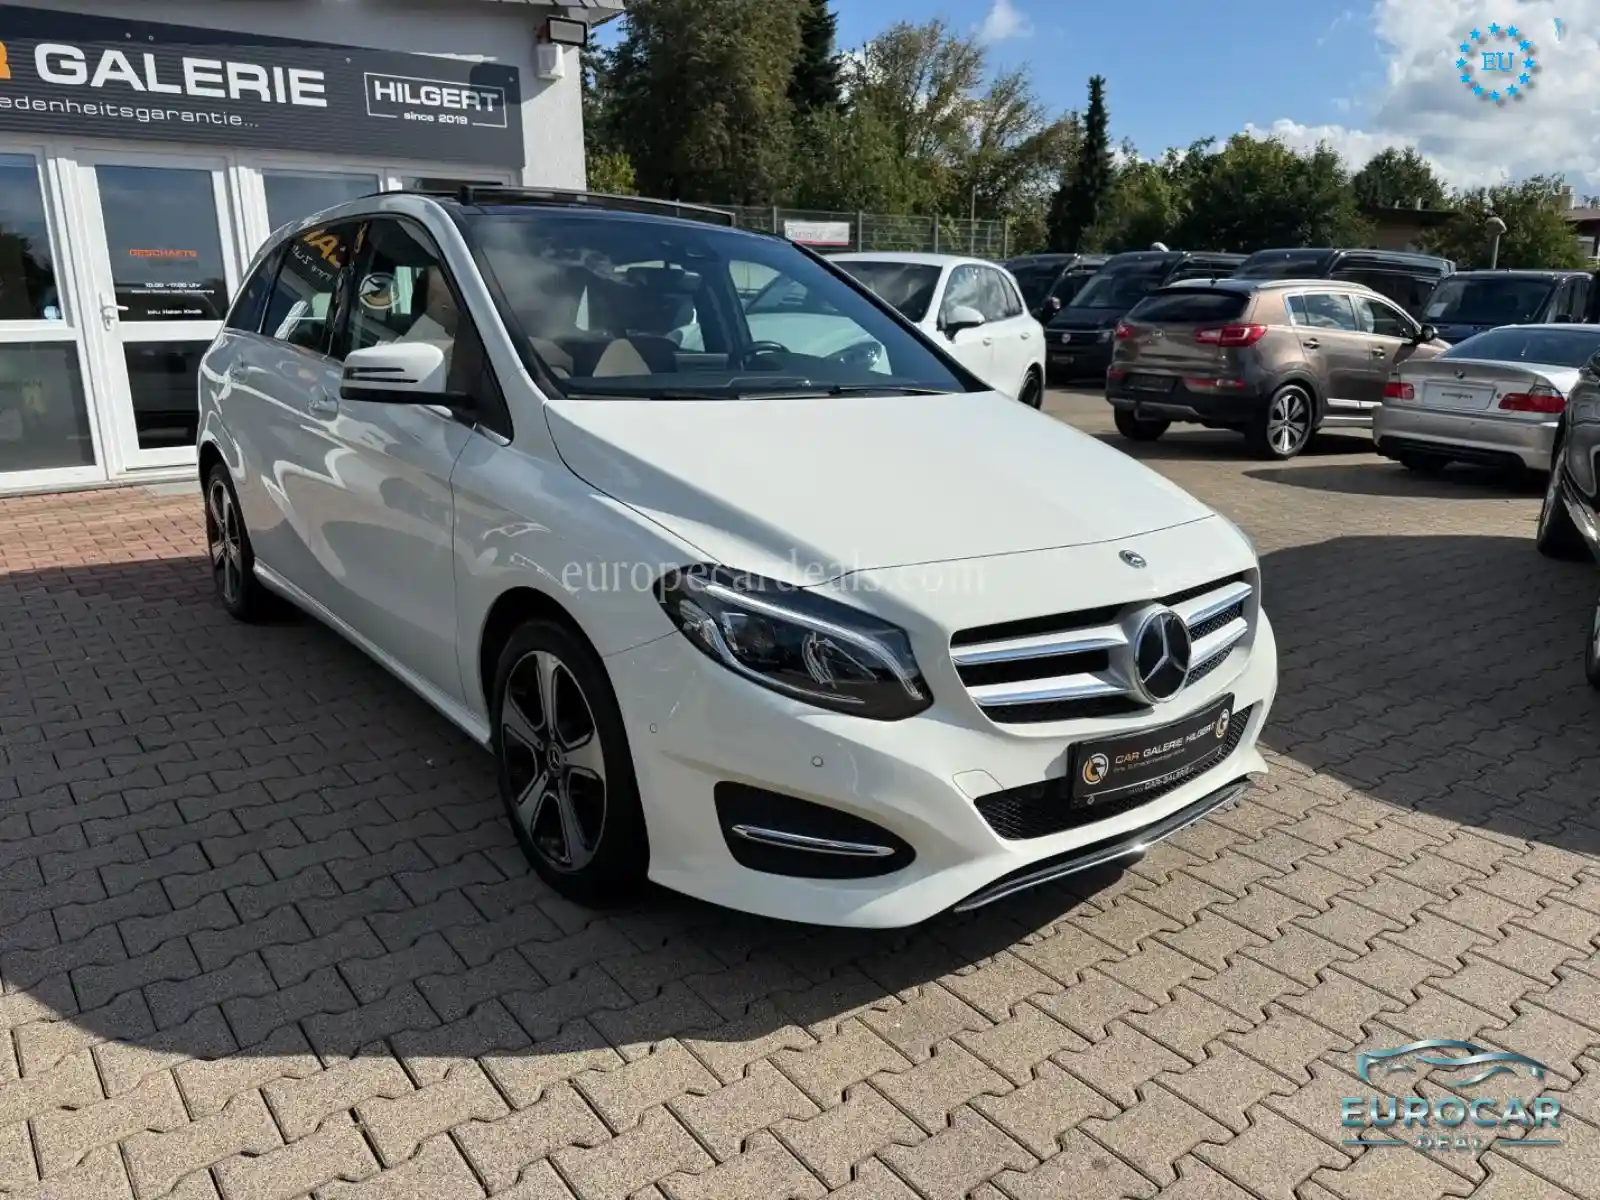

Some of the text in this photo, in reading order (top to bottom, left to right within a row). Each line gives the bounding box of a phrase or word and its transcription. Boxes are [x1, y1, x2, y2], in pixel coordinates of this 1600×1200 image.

[34, 43, 327, 107] GALERIE
[374, 80, 499, 112] HILGERT
[403, 111, 468, 125] since 2019
[1114, 751, 1141, 765] CAR
[1143, 737, 1184, 758] GALERIE
